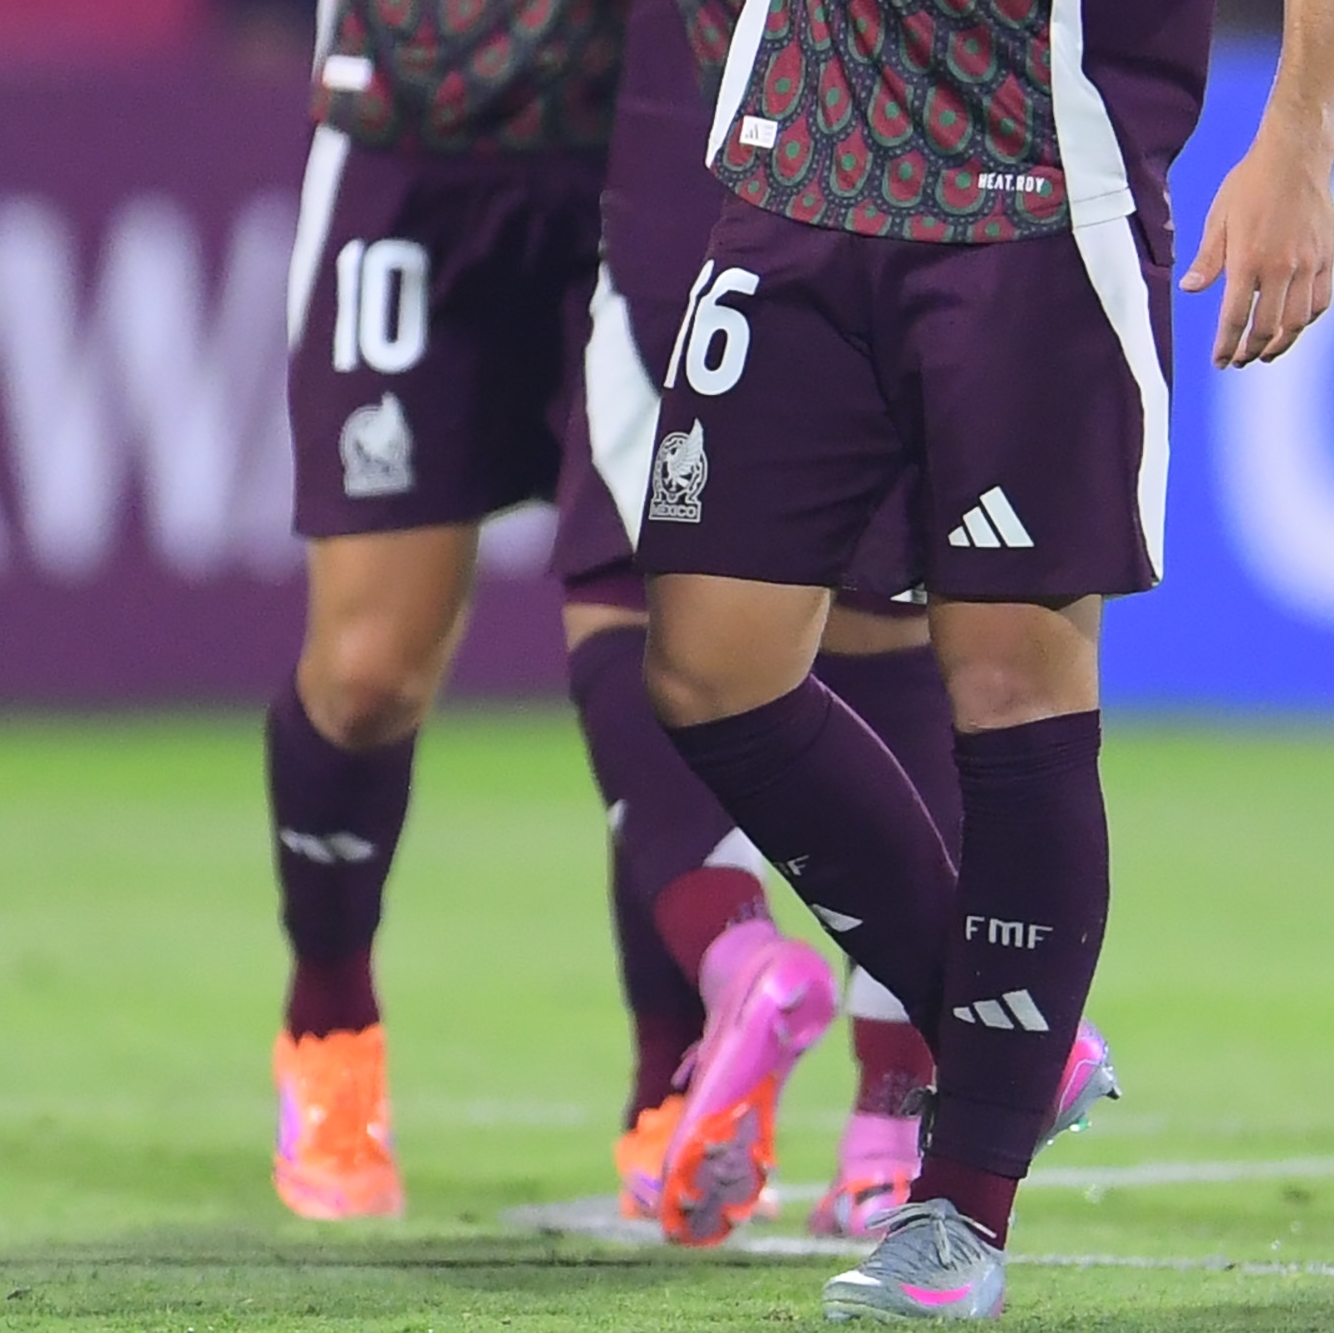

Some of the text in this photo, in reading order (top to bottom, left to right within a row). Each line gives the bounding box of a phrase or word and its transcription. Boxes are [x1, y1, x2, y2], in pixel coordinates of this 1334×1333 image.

[332, 238, 430, 374] 10
[663, 258, 760, 396] 16
[966, 915, 1053, 949] FMF
